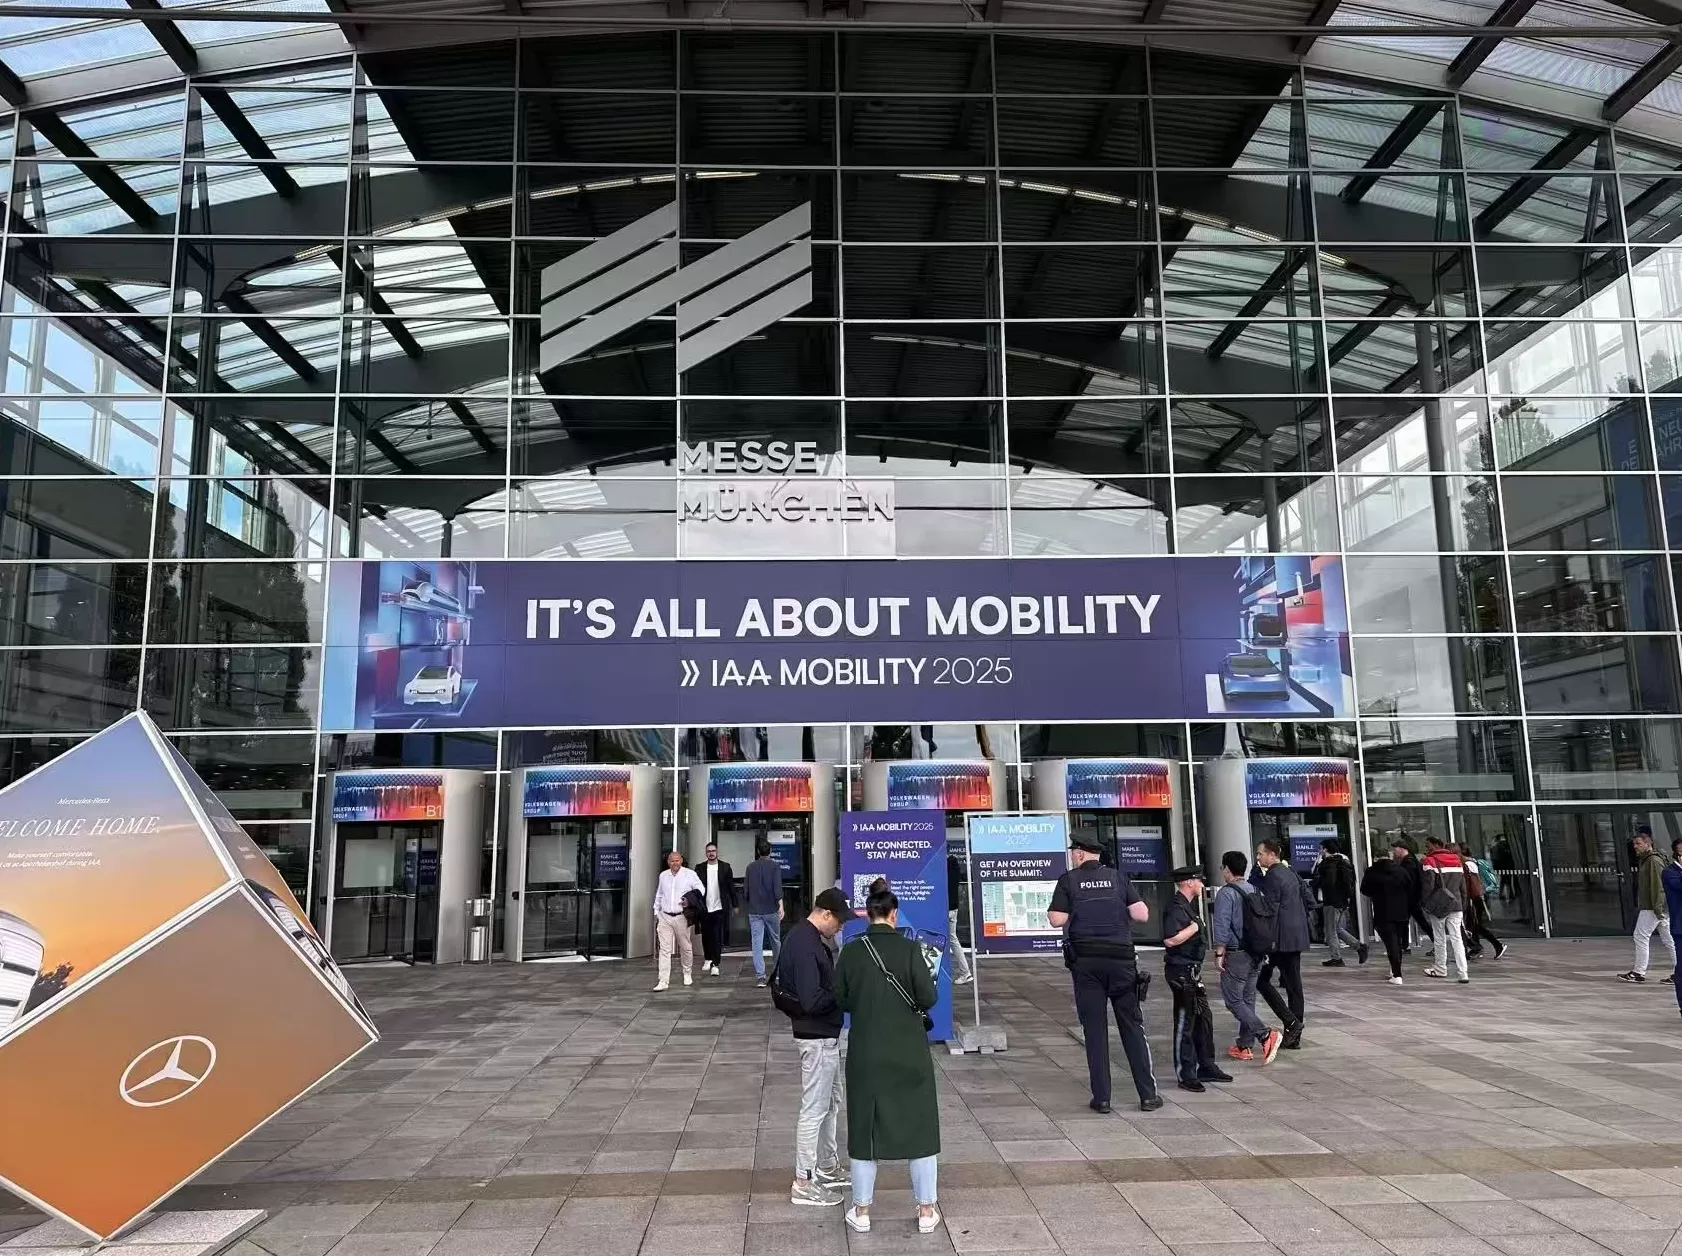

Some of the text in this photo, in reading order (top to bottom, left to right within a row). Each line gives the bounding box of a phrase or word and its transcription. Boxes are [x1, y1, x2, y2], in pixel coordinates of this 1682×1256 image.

[678, 441, 817, 474] MESSE
[678, 486, 895, 522] MÜNCHEN
[525, 595, 1161, 638] IT'S ALL ABOUT MOBILITY
[711, 657, 1013, 686] IAA MOBILITY 2025
[57, 797, 111, 806] Mercedes-Benz
[800, 797, 812, 808] B1
[980, 794, 992, 806] B1
[1161, 794, 1171, 806] B1
[1342, 792, 1351, 804] B1
[426, 805, 442, 817] B1
[616, 800, 631, 812] B1
[860, 824, 875, 832] IAA
[876, 823, 914, 831] MOBILITY
[988, 824, 1055, 834] IAA MOBILITY
[855, 840, 932, 850] STAY CONNECTED.
[890, 851, 920, 859] AHEAD.
[1080, 880, 1112, 889] POLIZEI
